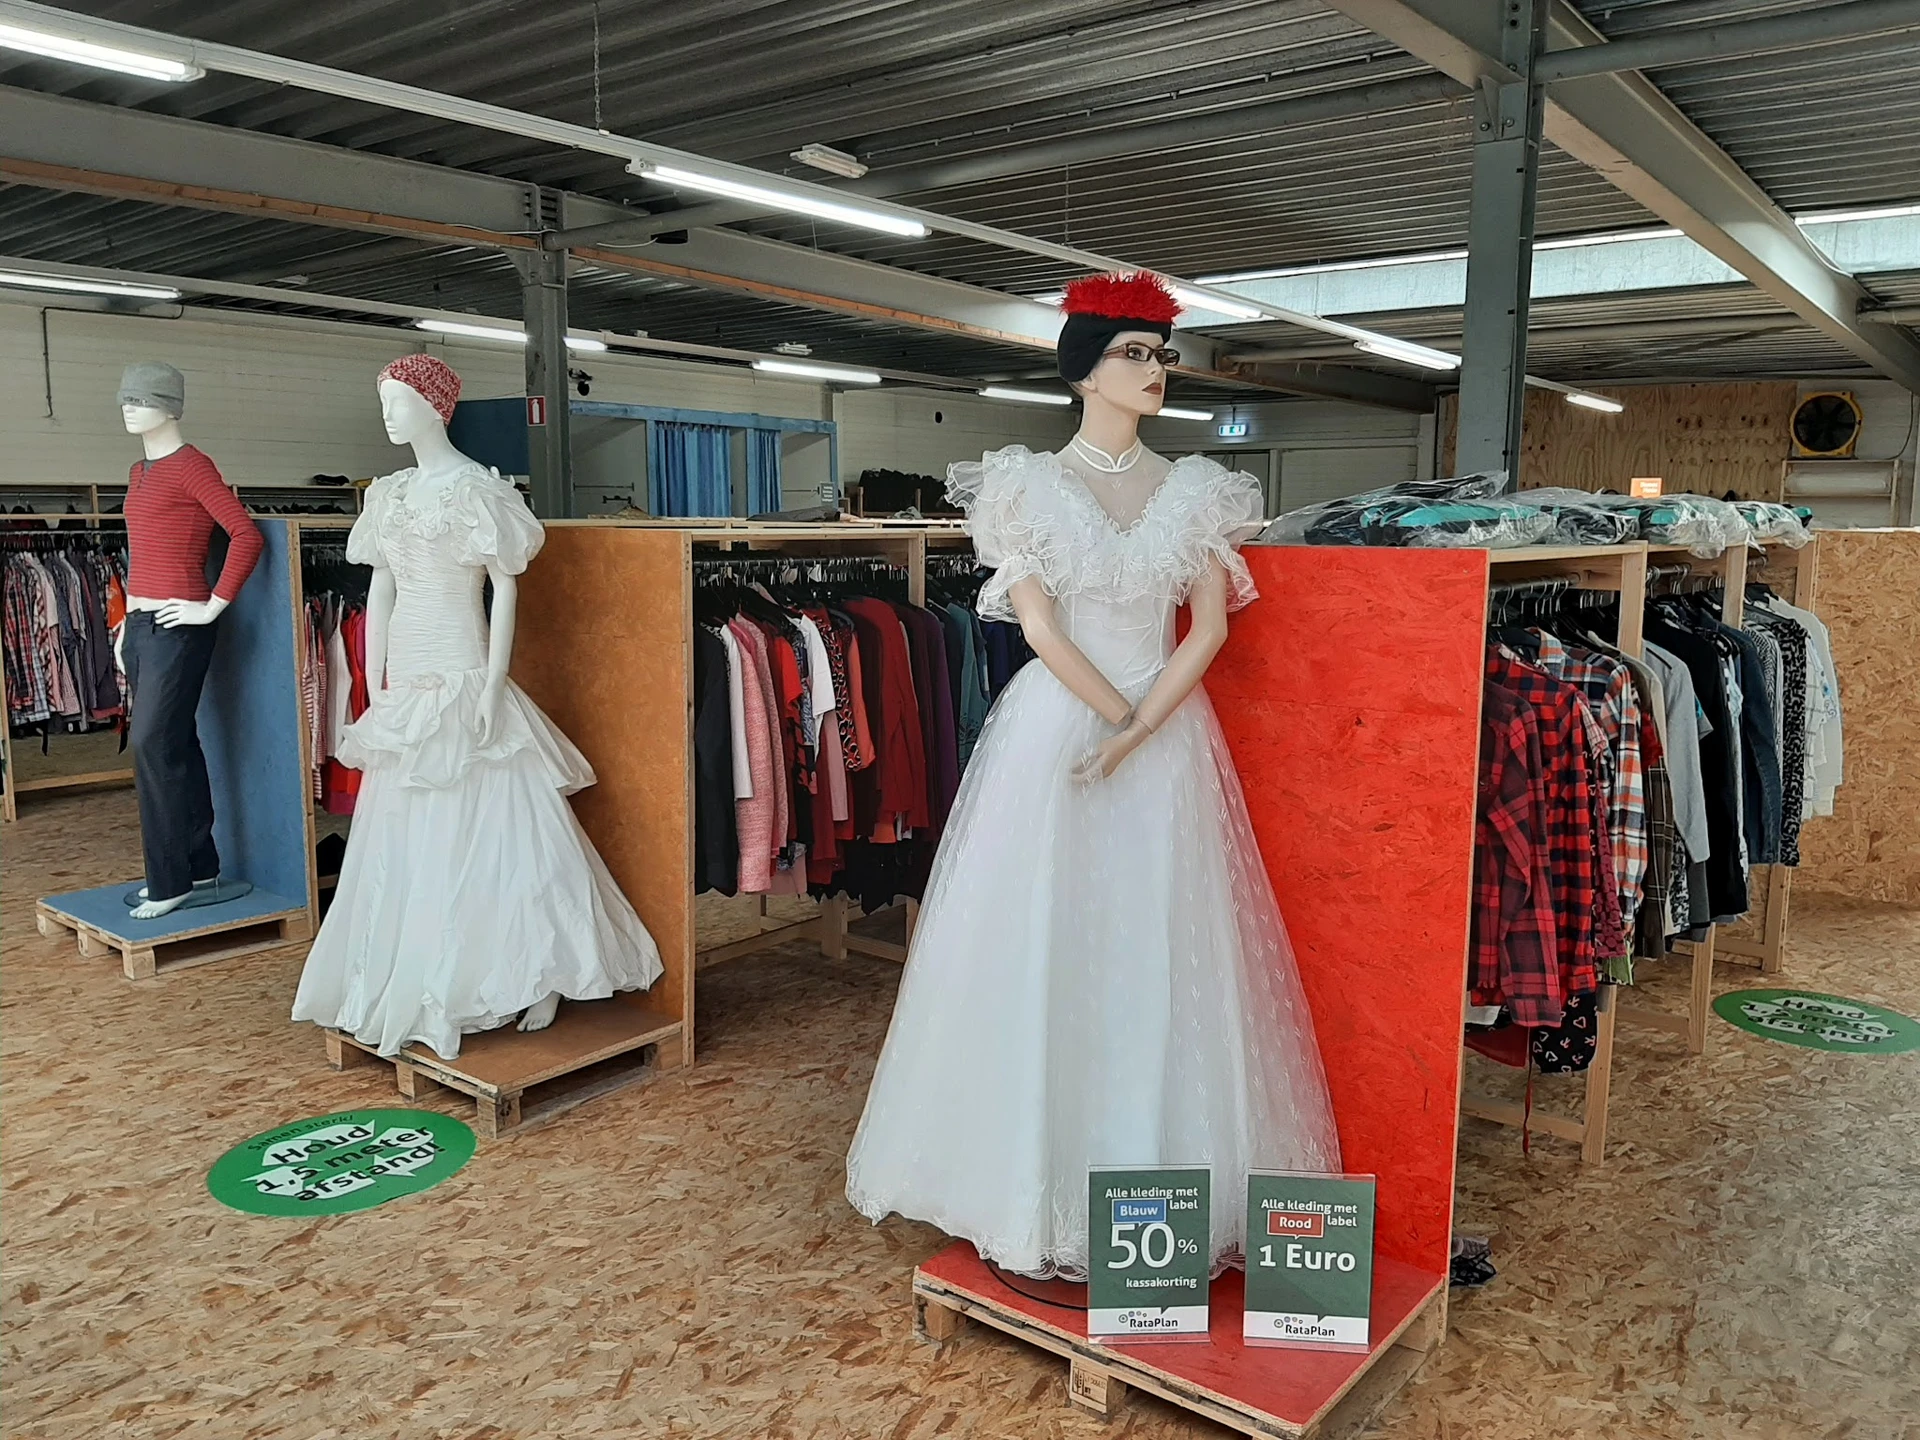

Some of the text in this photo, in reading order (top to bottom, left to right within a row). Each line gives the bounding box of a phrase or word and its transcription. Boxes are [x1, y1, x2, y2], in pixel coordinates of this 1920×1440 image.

[1783, 999, 1865, 1019] Houd
[1801, 1013, 1900, 1037] meter
[248, 1114, 353, 1151] Samen sterk!
[271, 1126, 372, 1165] Houd
[324, 1126, 428, 1168] meter
[294, 1140, 446, 1201] afstand!
[1105, 1187, 1198, 1199] Alle kleding met
[1120, 1199, 1198, 1217] Blauw label
[1261, 1199, 1358, 1214] Alle kleding met
[1279, 1215, 1358, 1229] Rood label
[1259, 1243, 1356, 1272] 1 Euro
[1126, 1277, 1197, 1289] kassakorting
[1129, 1318, 1179, 1328] RataPlan
[1285, 1324, 1335, 1337] RataPlan
